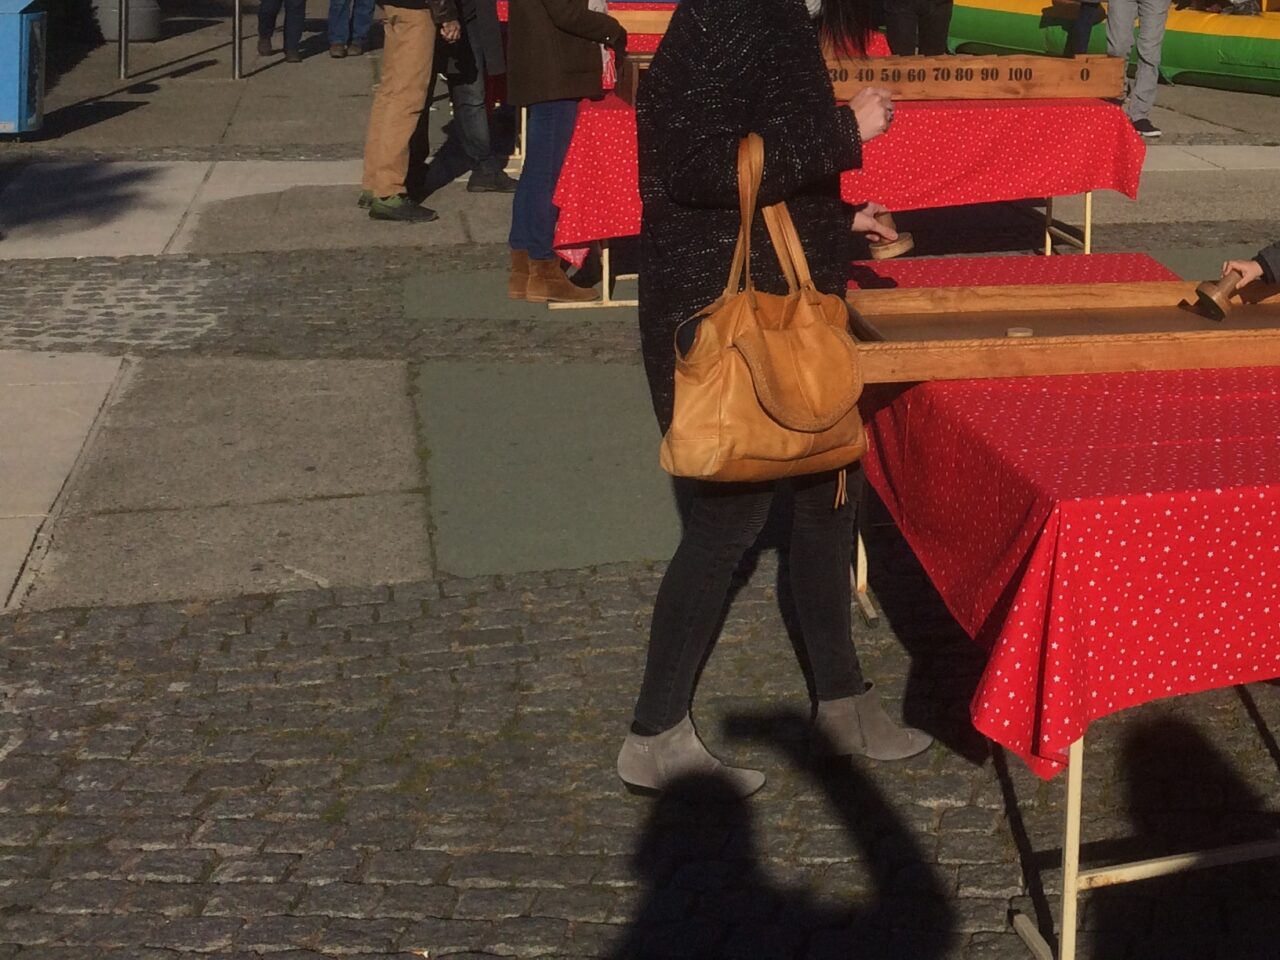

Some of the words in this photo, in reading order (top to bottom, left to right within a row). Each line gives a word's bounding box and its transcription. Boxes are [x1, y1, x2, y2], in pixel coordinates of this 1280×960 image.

[854, 68, 874, 82] 40
[880, 68, 901, 82] 50
[907, 68, 926, 82] 60
[932, 67, 951, 82] 70
[954, 67, 974, 81] 80
[980, 67, 999, 81] 90
[1007, 67, 1033, 81] 100
[1080, 67, 1090, 81] 0
